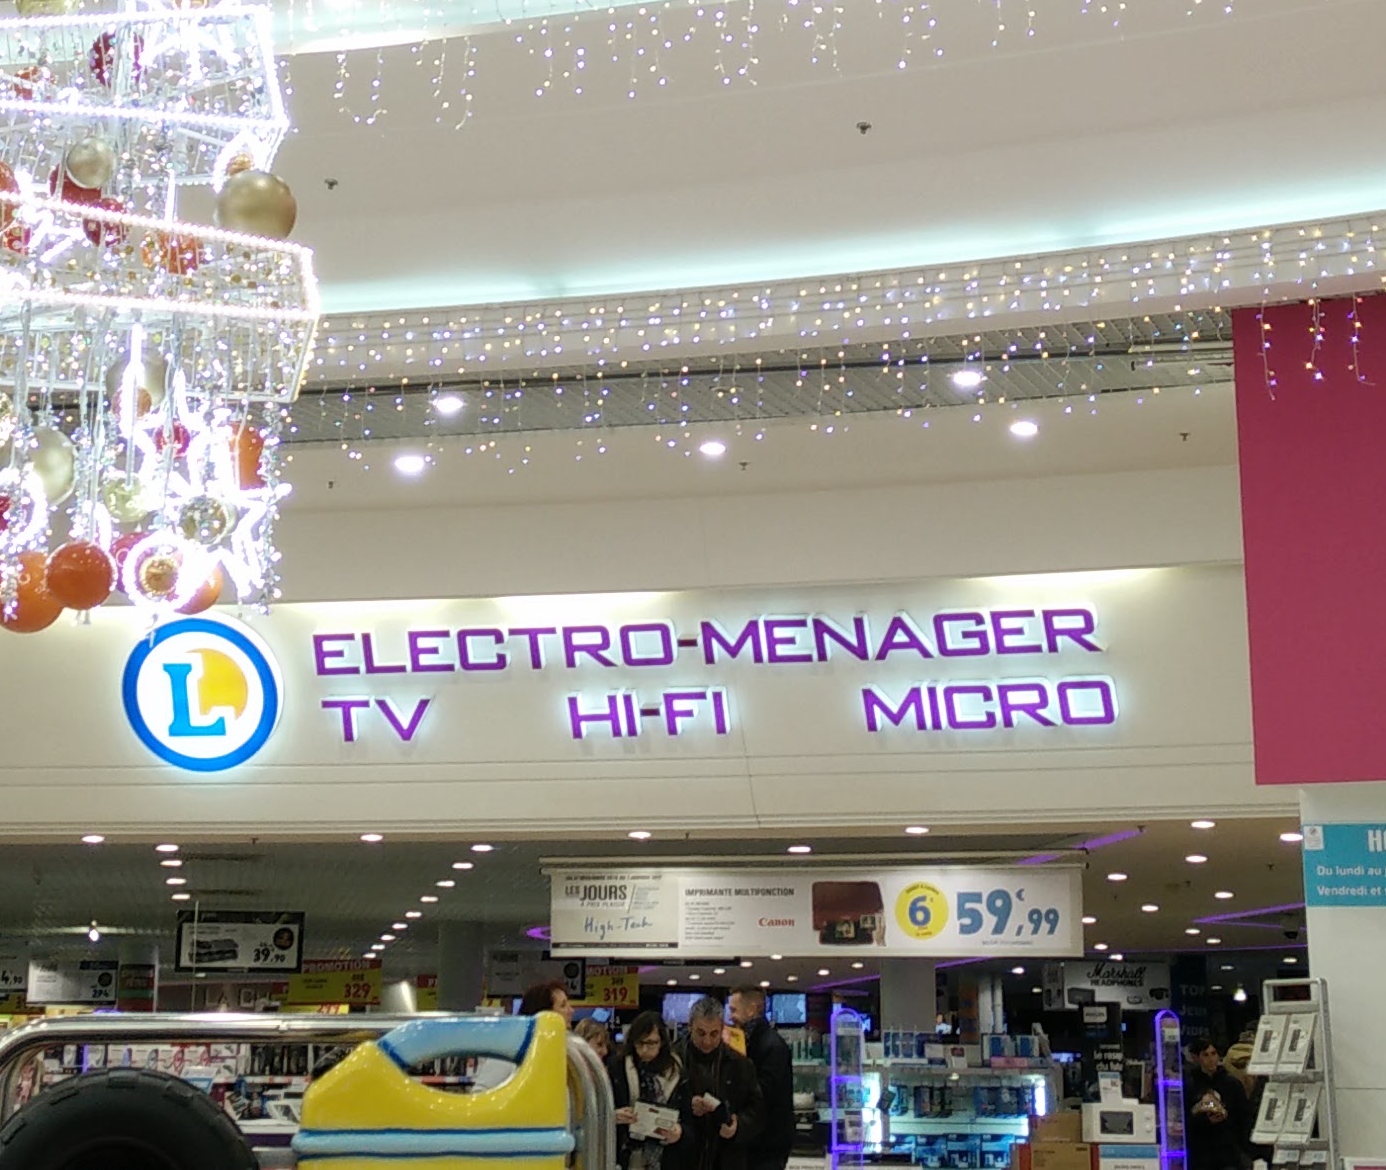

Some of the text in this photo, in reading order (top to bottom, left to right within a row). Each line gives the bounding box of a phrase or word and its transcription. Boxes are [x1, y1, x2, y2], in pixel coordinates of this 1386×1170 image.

[312, 608, 1104, 676] ELECTRO-MENAGER
[320, 680, 1116, 743] TV HI-FI MICRO
[1317, 865, 1334, 876] Du
[1335, 864, 1365, 876] lundi
[1367, 867, 1382, 876] au
[565, 885, 580, 896] LES
[580, 884, 628, 902] JOURS
[684, 888, 733, 897] IMPRIMANTE
[1317, 884, 1368, 896] Vendredi
[1370, 885, 1382, 896] et
[758, 917, 795, 927] Canon
[301, 960, 370, 974] PROMOTION
[1086, 962, 1147, 979] Marshall
[343, 982, 372, 999] 329
